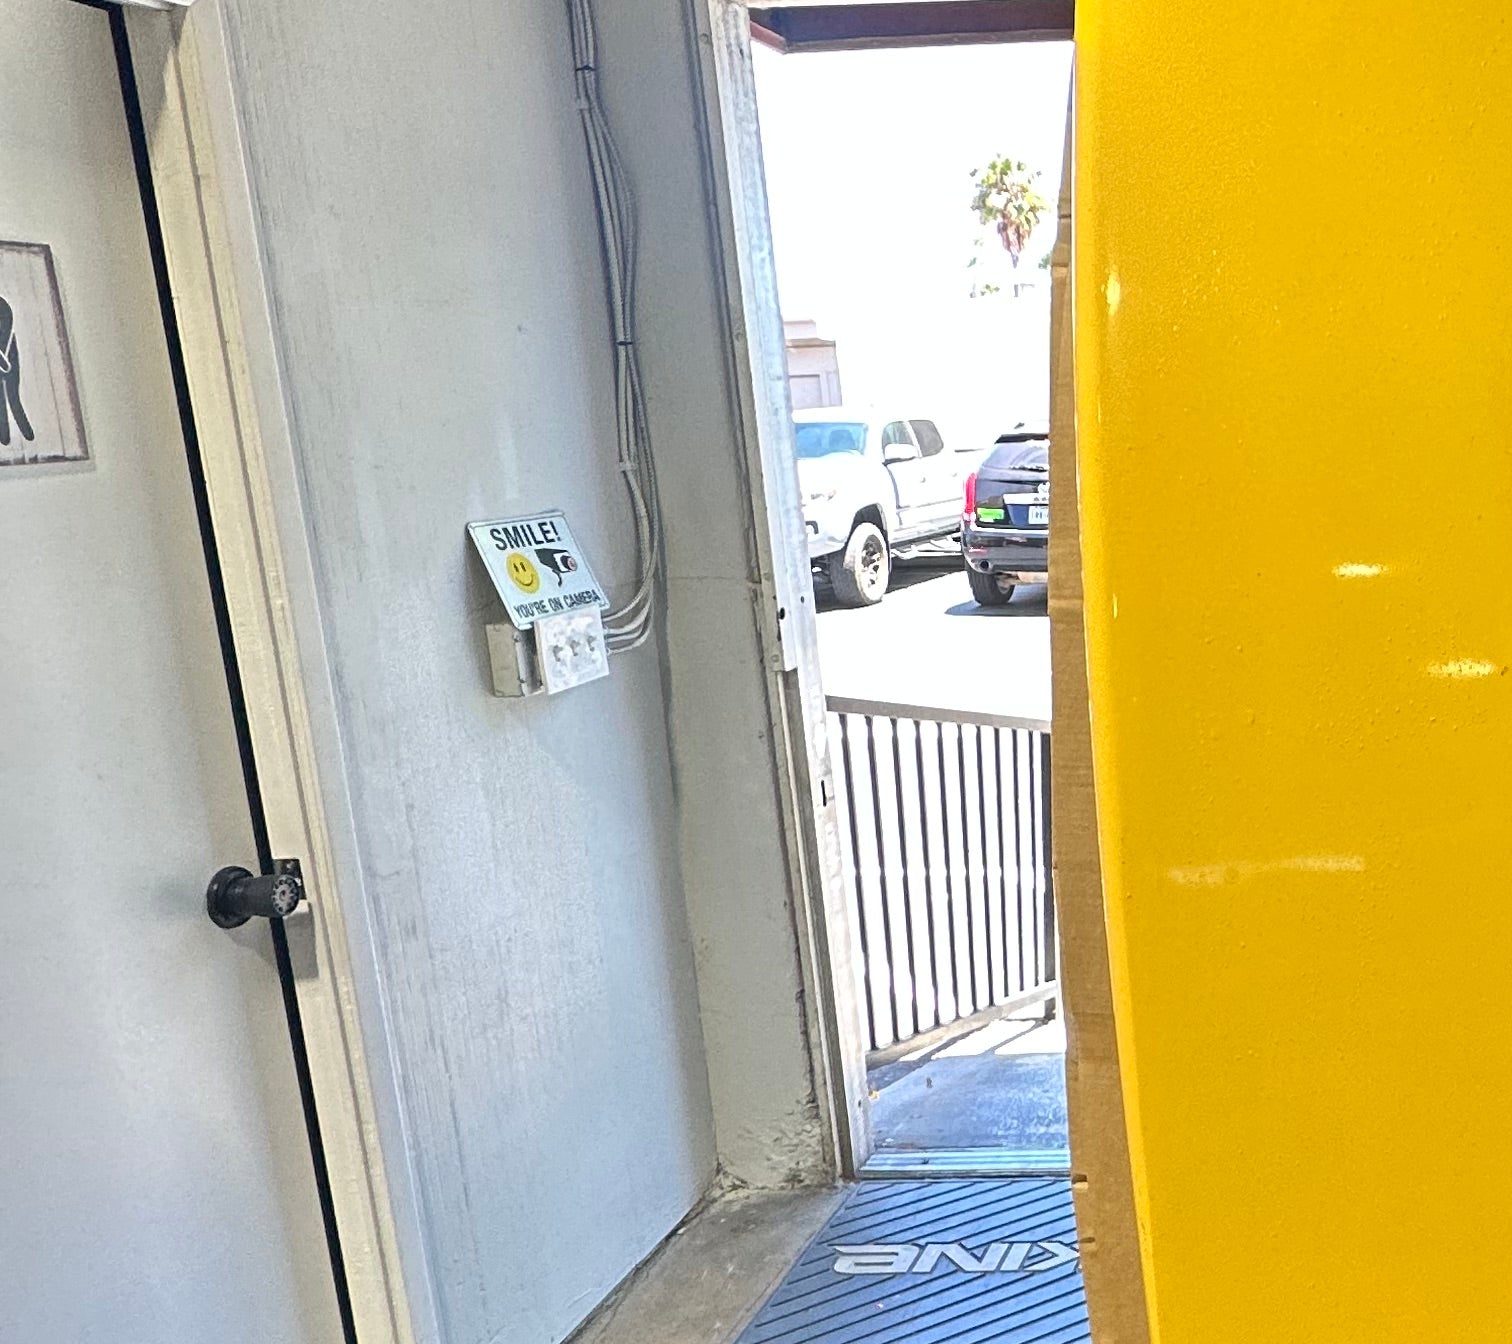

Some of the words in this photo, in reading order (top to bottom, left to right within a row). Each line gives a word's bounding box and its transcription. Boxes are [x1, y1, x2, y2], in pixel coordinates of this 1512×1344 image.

[490, 521, 561, 551] SMILE!
[513, 599, 549, 618] YOU'RE
[547, 596, 565, 612] ON
[563, 589, 601, 609] CAMERA
